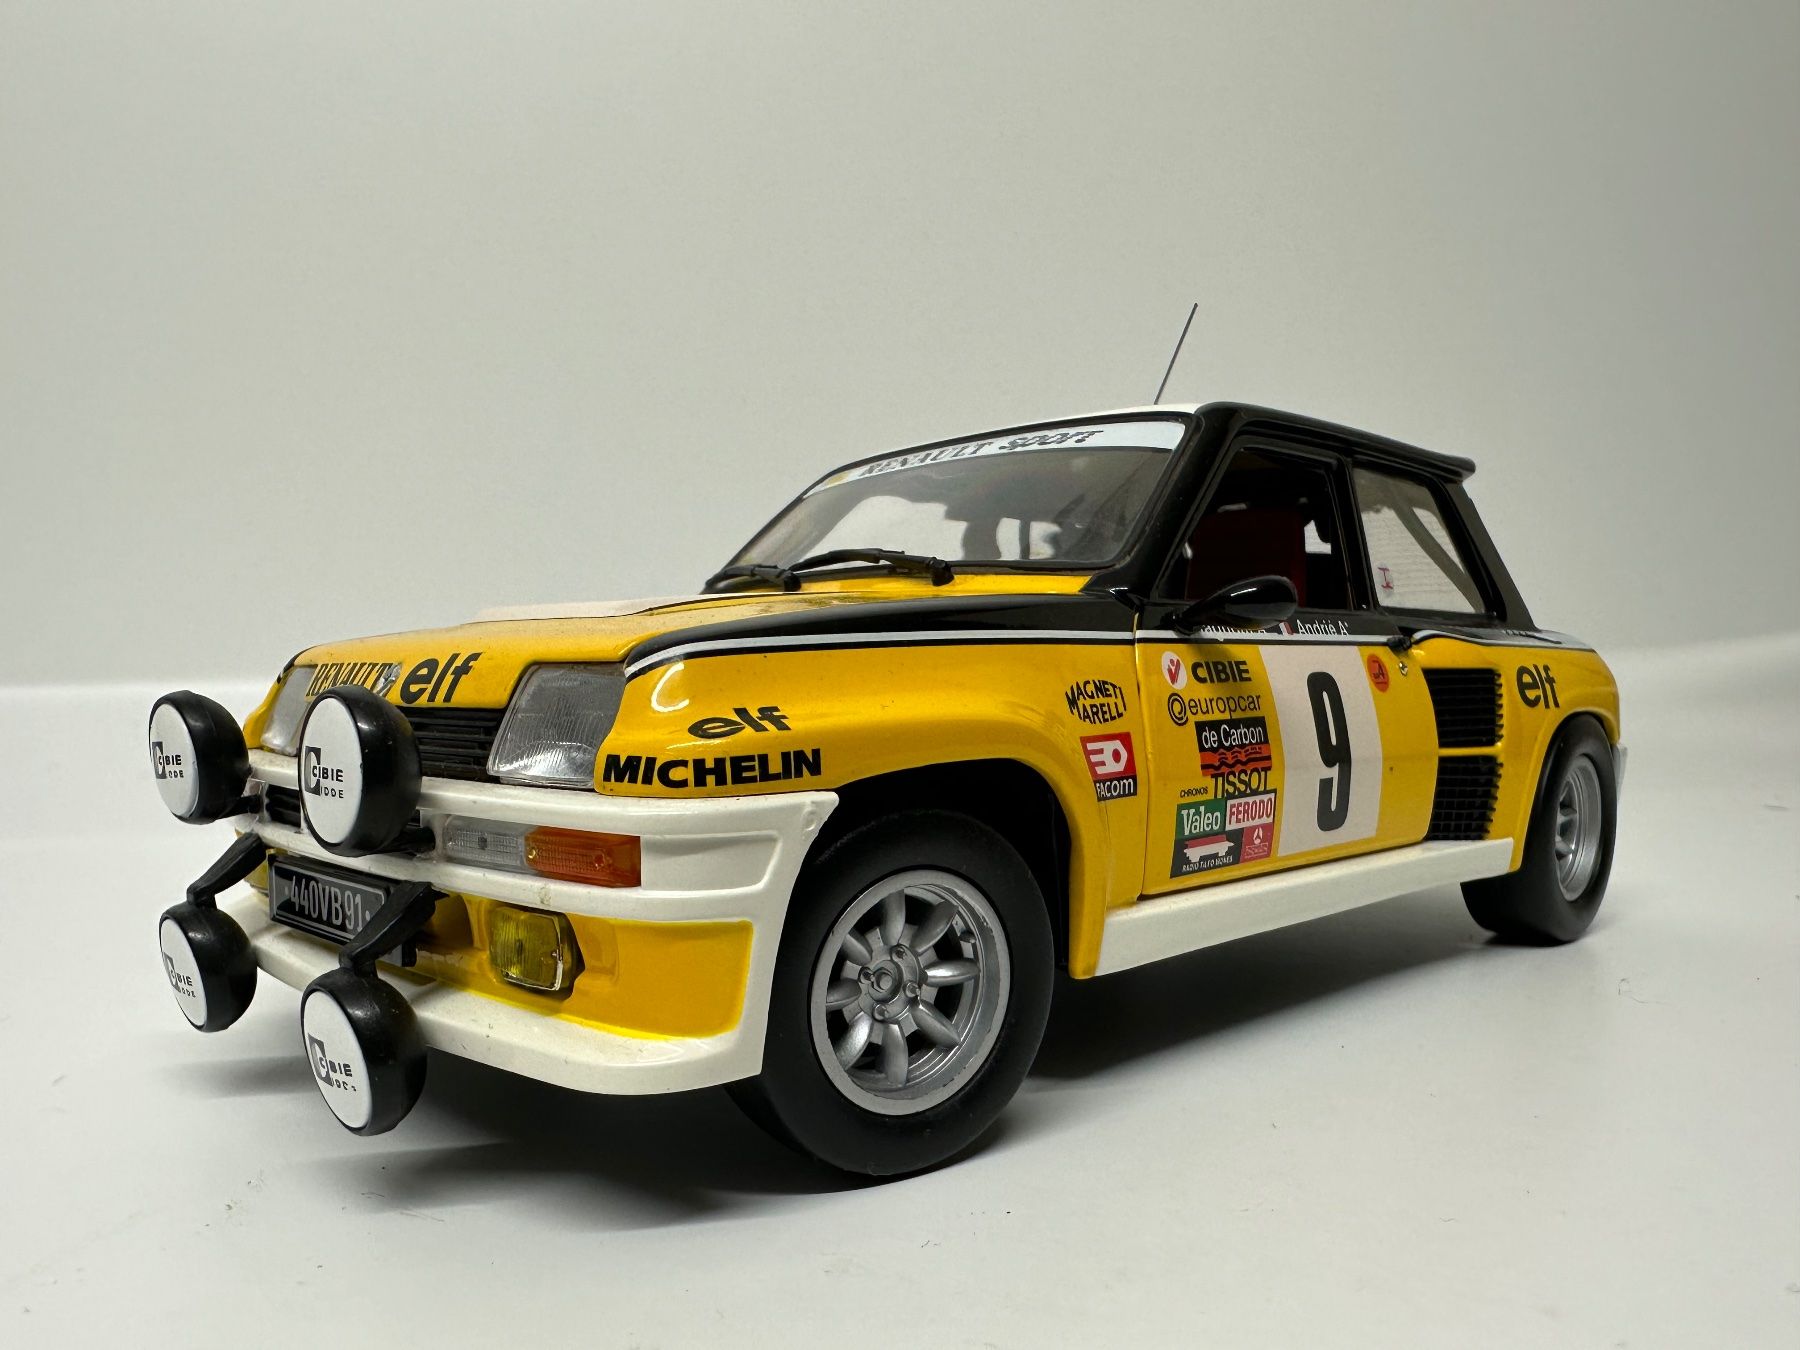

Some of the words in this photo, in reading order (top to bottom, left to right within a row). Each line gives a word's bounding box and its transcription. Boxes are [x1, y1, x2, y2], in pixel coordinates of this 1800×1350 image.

[859, 441, 994, 477] RENAULT
[400, 652, 483, 705] elf
[1191, 660, 1252, 684] CIBIE
[1516, 664, 1560, 709] elf
[688, 706, 792, 739] elf
[1202, 726, 1219, 749] de
[1220, 723, 1264, 747] Carbon
[1307, 671, 1352, 831] 9
[312, 765, 344, 782] CIBIE
[602, 748, 822, 788] MICHELIN
[1211, 767, 1271, 798] TISSOT
[1181, 805, 1221, 836] Valeo
[1228, 797, 1273, 826] FERODO
